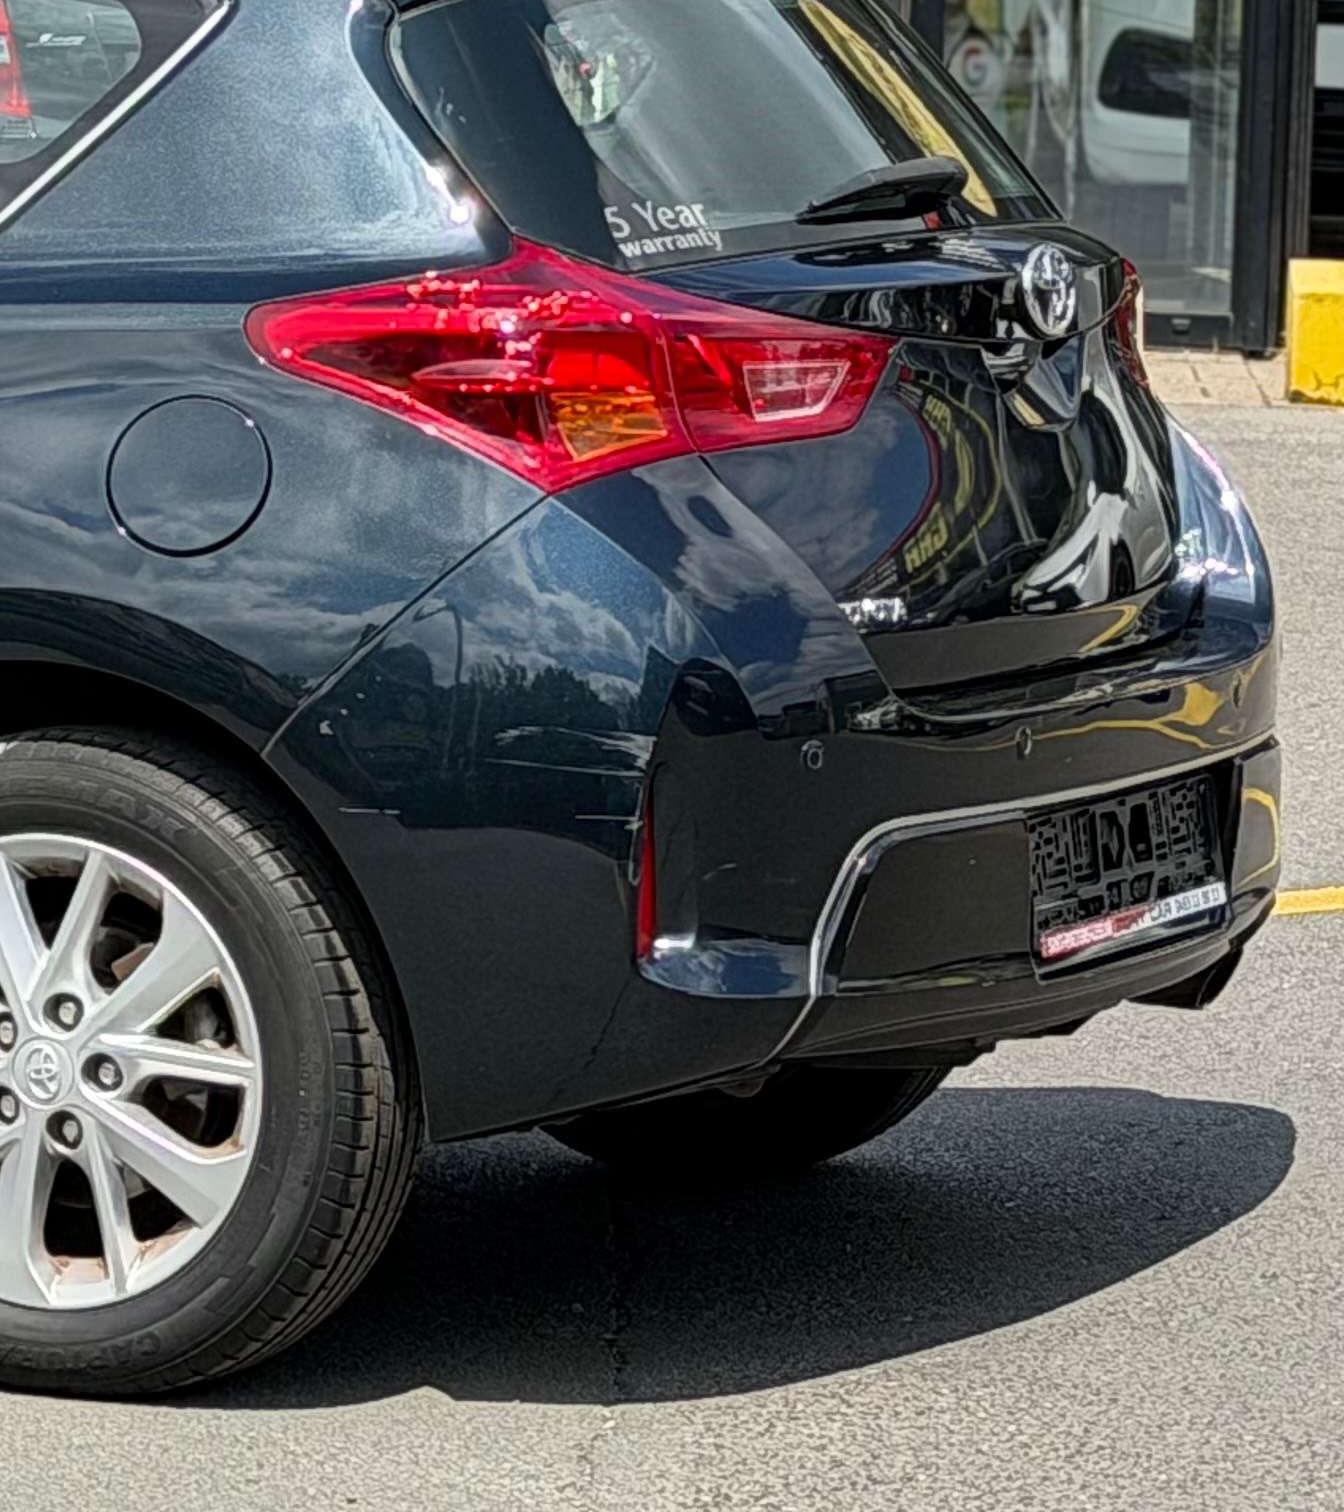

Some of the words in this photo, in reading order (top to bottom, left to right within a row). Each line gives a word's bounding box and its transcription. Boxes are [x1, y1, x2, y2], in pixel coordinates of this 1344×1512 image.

[603, 205, 632, 239] 5
[630, 199, 708, 232] Year
[617, 227, 723, 258] warranty
